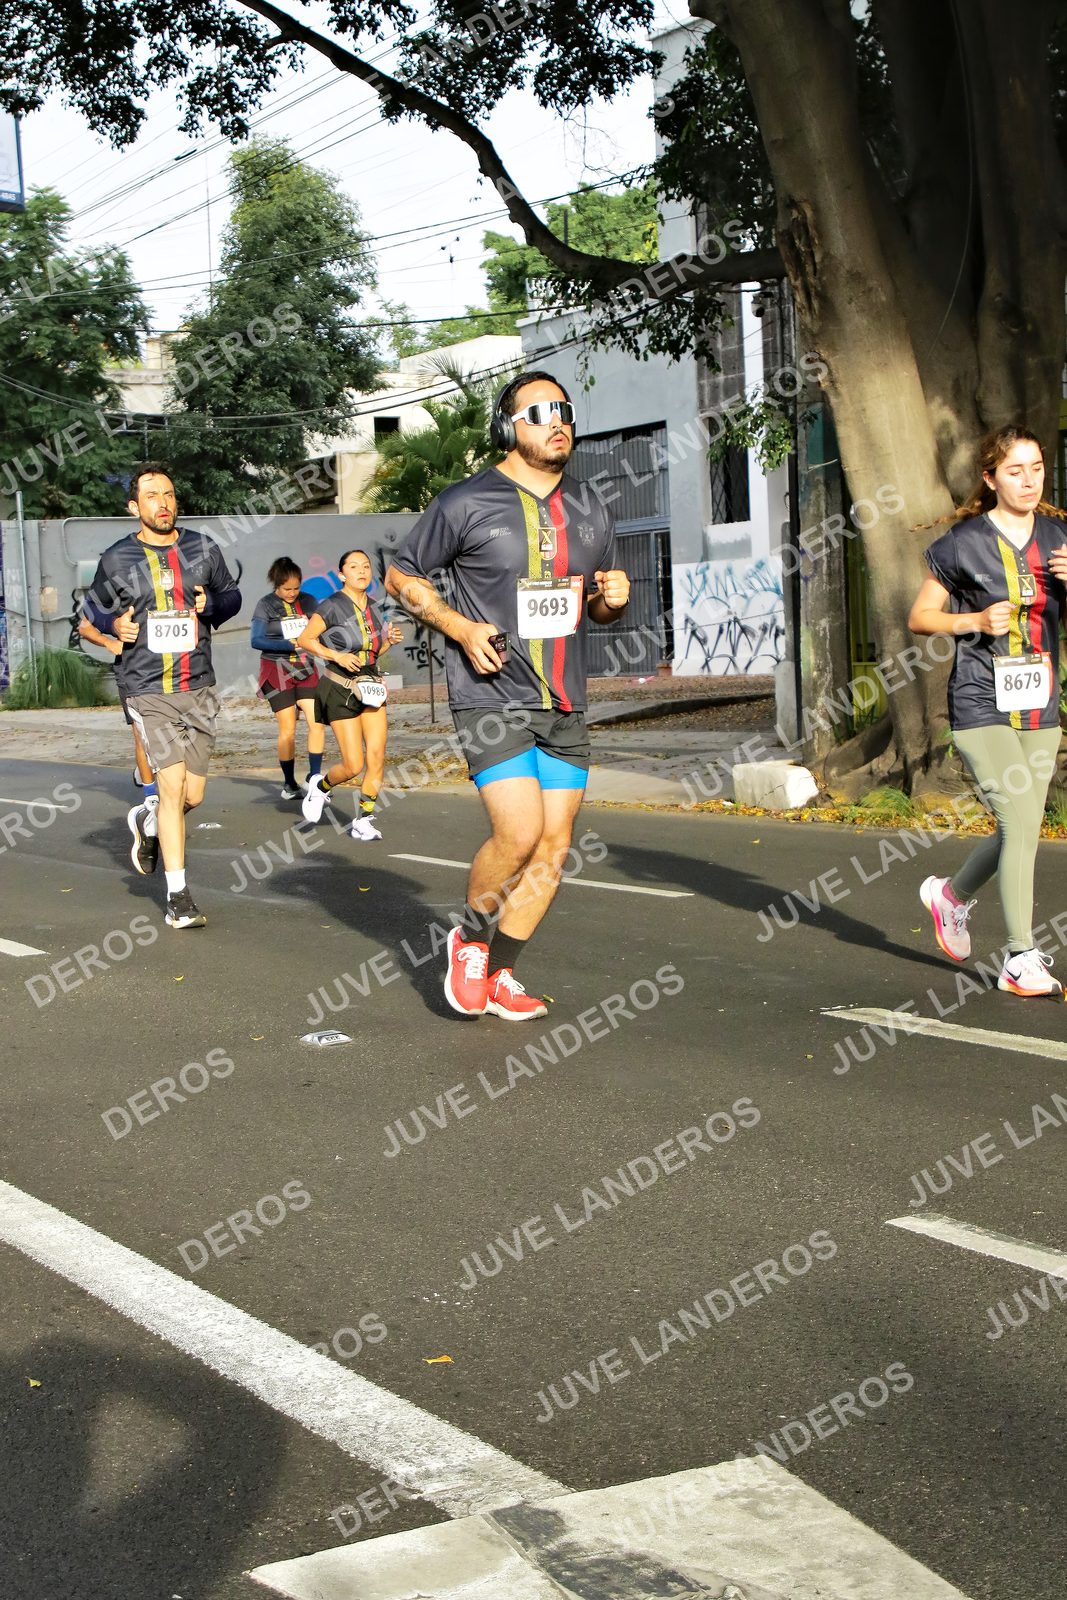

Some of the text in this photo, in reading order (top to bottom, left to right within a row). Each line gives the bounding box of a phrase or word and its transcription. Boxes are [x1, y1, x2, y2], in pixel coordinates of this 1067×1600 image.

[527, 596, 569, 617] 9693
[154, 623, 189, 638] 8705
[1003, 671, 1042, 692] 8679
